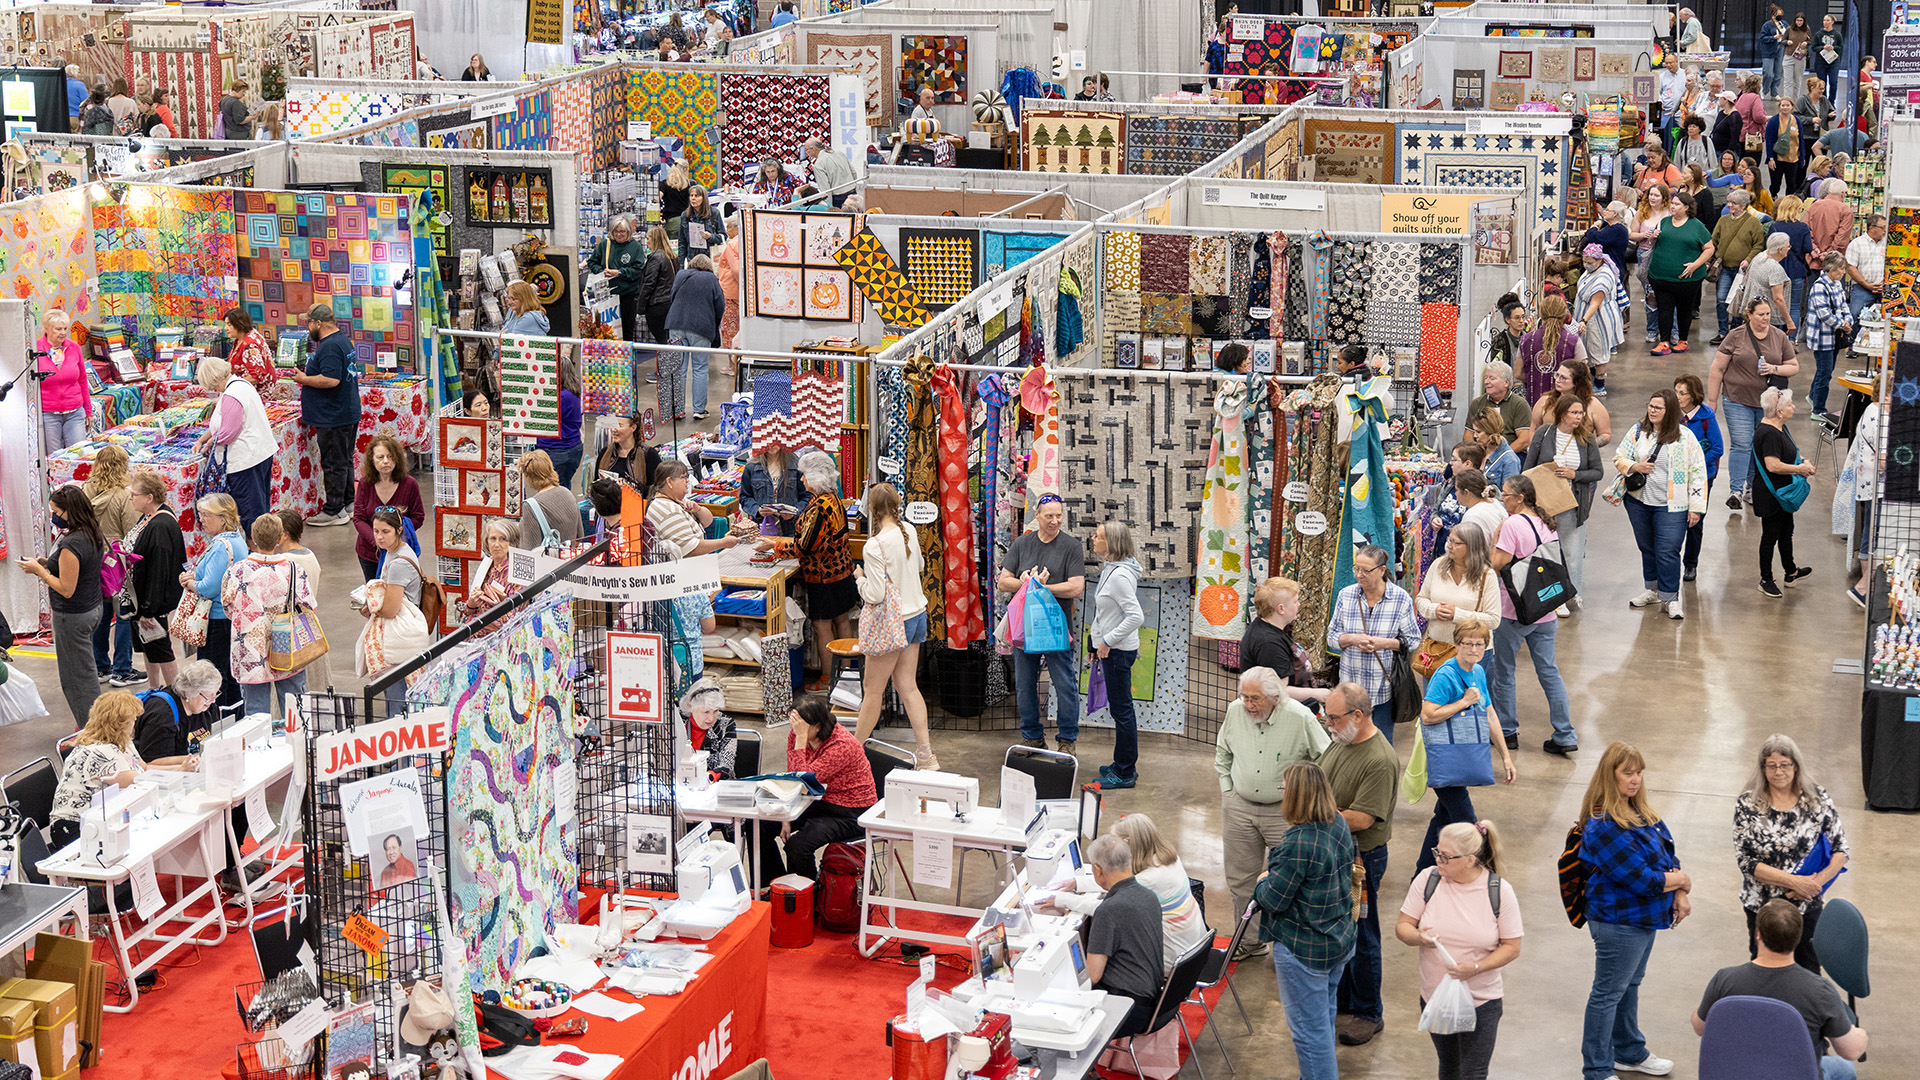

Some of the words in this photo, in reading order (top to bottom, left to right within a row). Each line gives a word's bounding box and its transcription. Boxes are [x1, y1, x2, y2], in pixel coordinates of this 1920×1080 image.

[534, 18, 547, 26] baby
[533, 26, 546, 34] baby
[533, 35, 546, 43] baby
[1890, 49, 1909, 57] 30%
[1250, 192, 1259, 200] The
[1259, 192, 1270, 201] Quilt
[1270, 193, 1287, 202] Keeper
[1392, 213, 1419, 222] Show
[1421, 213, 1435, 224] off
[1437, 215, 1460, 225] your
[1392, 224, 1419, 233] quilts
[1421, 225, 1443, 233] with
[563, 573, 627, 589] anome/Ardyth's
[629, 576, 648, 588] Sew
[650, 575, 657, 586] N
[659, 573, 676, 585] Vac
[614, 646, 655, 656] JANOME
[324, 721, 447, 774] JANOME
[354, 917, 376, 936] DREAM
[346, 928, 378, 953] JANOME
[672, 1011, 732, 1080] OME
